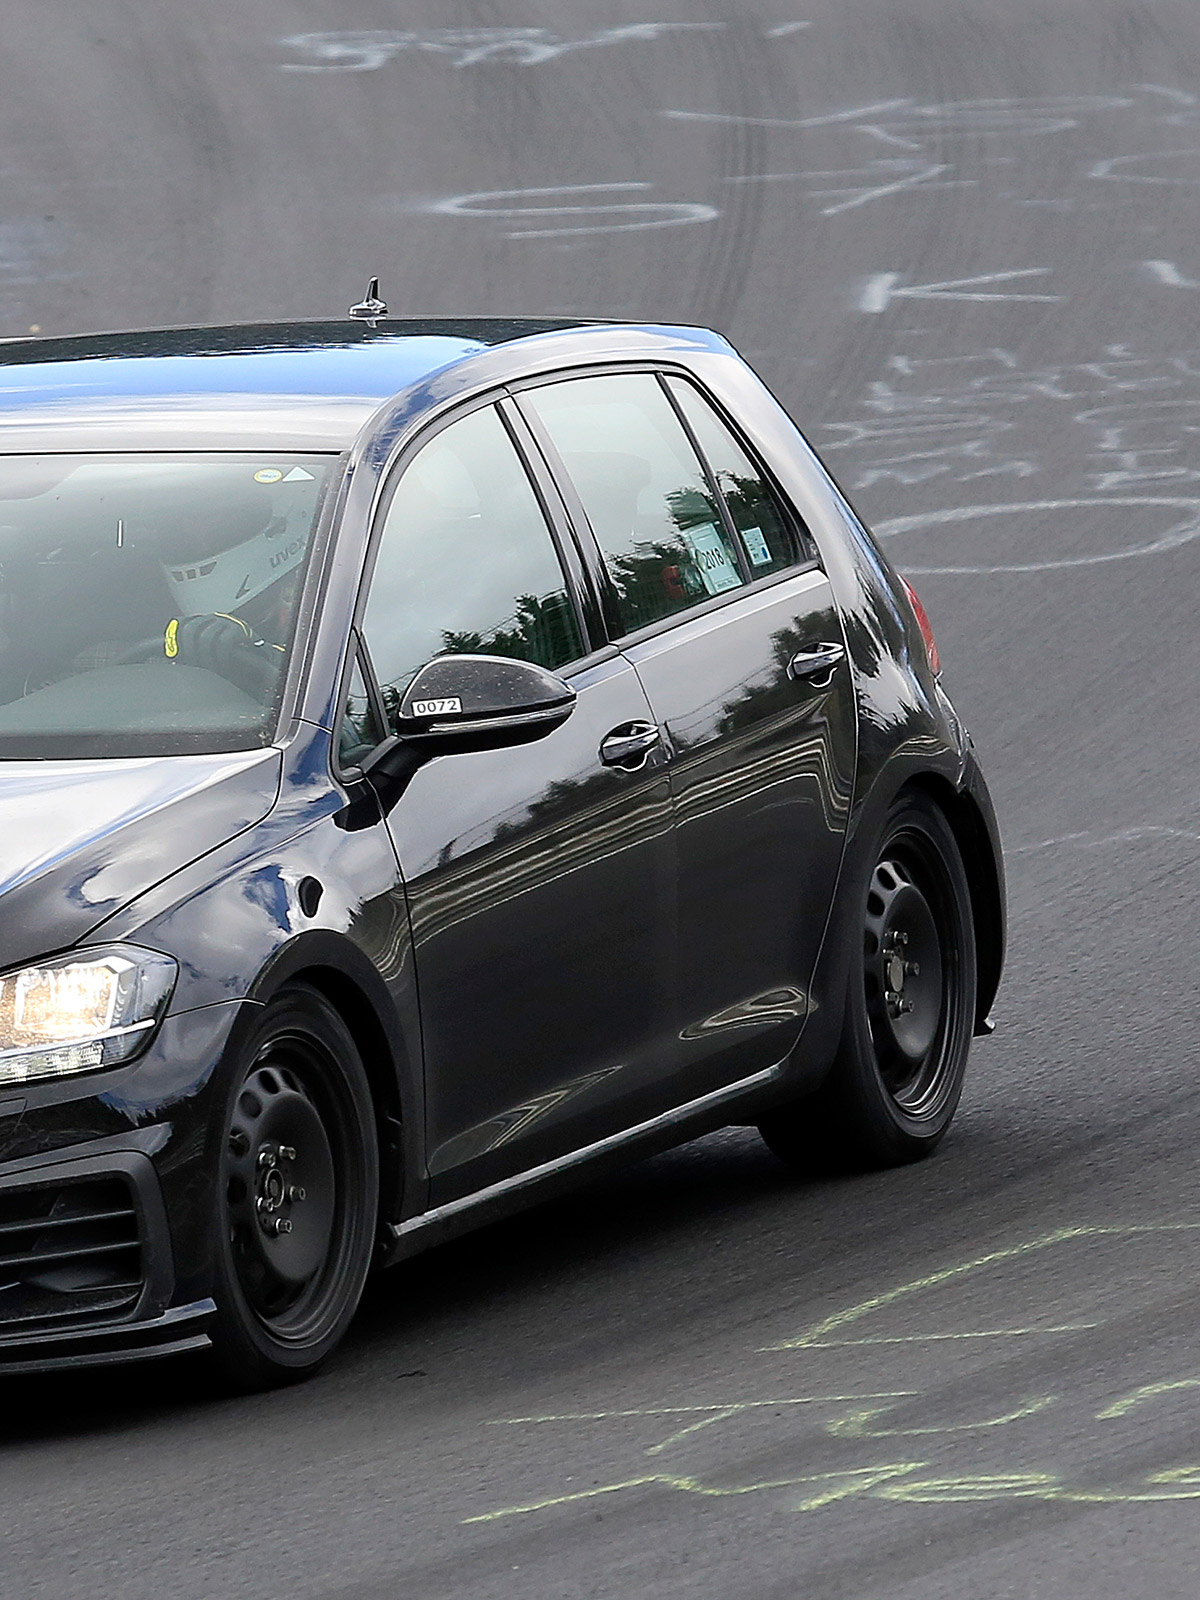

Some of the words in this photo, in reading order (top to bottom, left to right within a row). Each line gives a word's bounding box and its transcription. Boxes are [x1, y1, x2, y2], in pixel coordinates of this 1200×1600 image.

[269, 536, 306, 569] uvex
[701, 547, 726, 570] 2018
[416, 700, 458, 714] 0072
